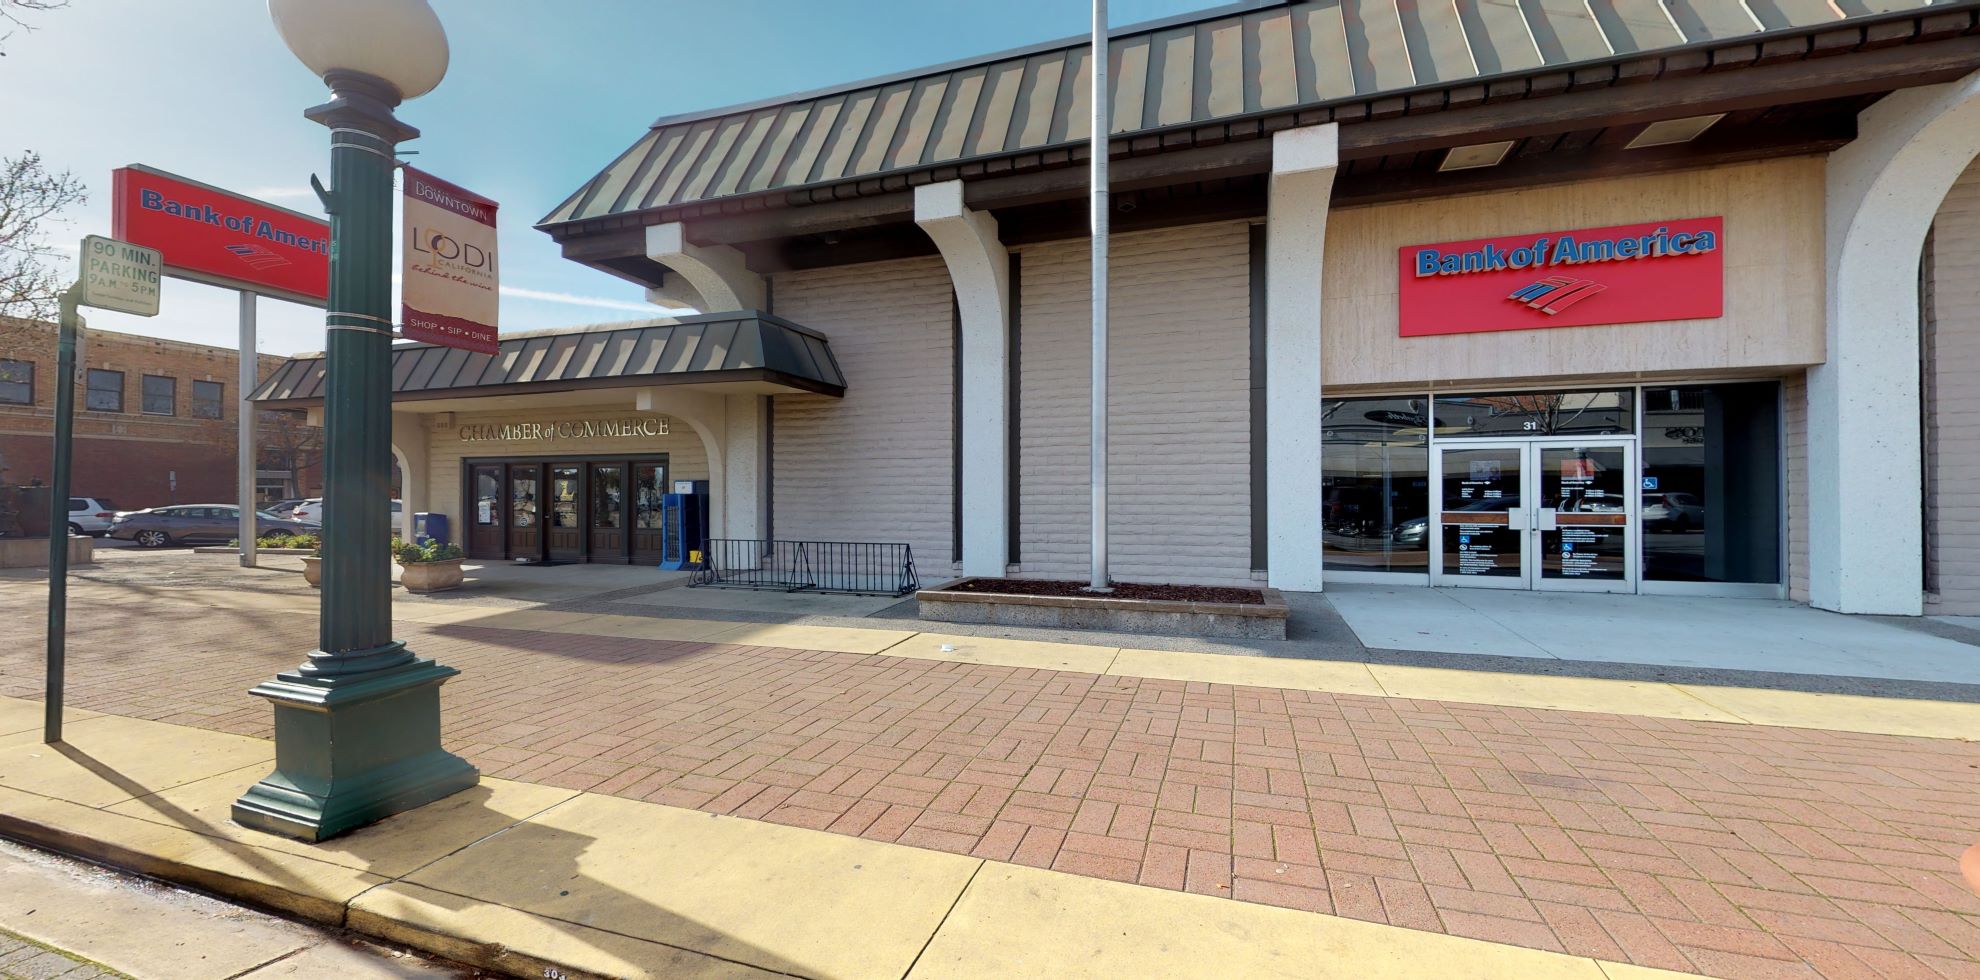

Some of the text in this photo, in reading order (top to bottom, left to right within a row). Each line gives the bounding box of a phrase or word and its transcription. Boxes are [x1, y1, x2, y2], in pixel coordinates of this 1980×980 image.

[416, 181, 488, 221] DOWNTOWN
[141, 188, 221, 226] Bank
[224, 216, 253, 234] of
[256, 221, 331, 256] Ameri
[94, 241, 156, 267] 90 MIN.
[413, 227, 492, 272] LODI
[1416, 227, 1717, 278] Bank of America
[90, 258, 157, 284] PARKING
[438, 259, 493, 279] CALIFORNIA
[131, 282, 156, 297] 5PM
[410, 319, 493, 342] SHOP SIP DINE
[459, 418, 670, 442] CHAMBER of COMMERCE
[1523, 421, 1537, 430] 31
